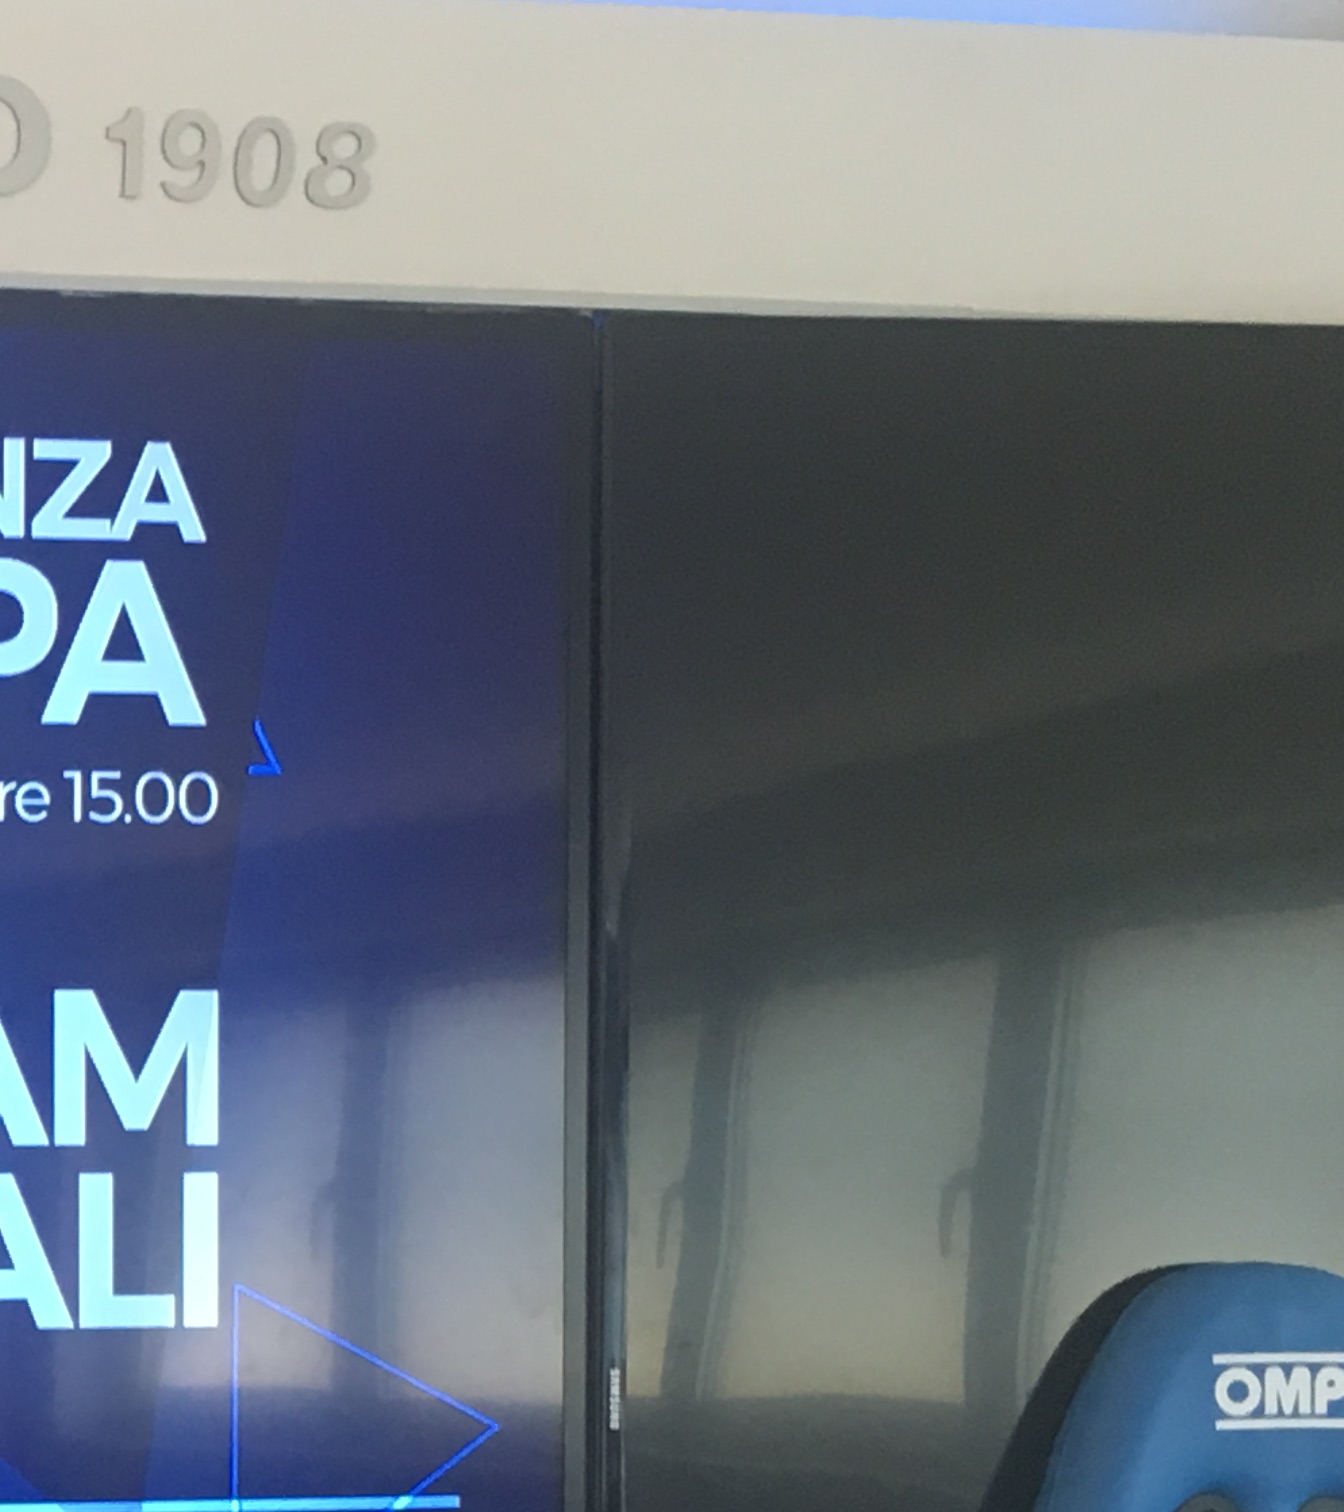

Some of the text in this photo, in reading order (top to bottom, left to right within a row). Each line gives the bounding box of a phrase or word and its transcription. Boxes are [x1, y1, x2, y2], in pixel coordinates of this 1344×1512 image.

[105, 106, 377, 209] 1908
[63, 770, 219, 826] 15.00
[1214, 1365, 1344, 1417] OMP
